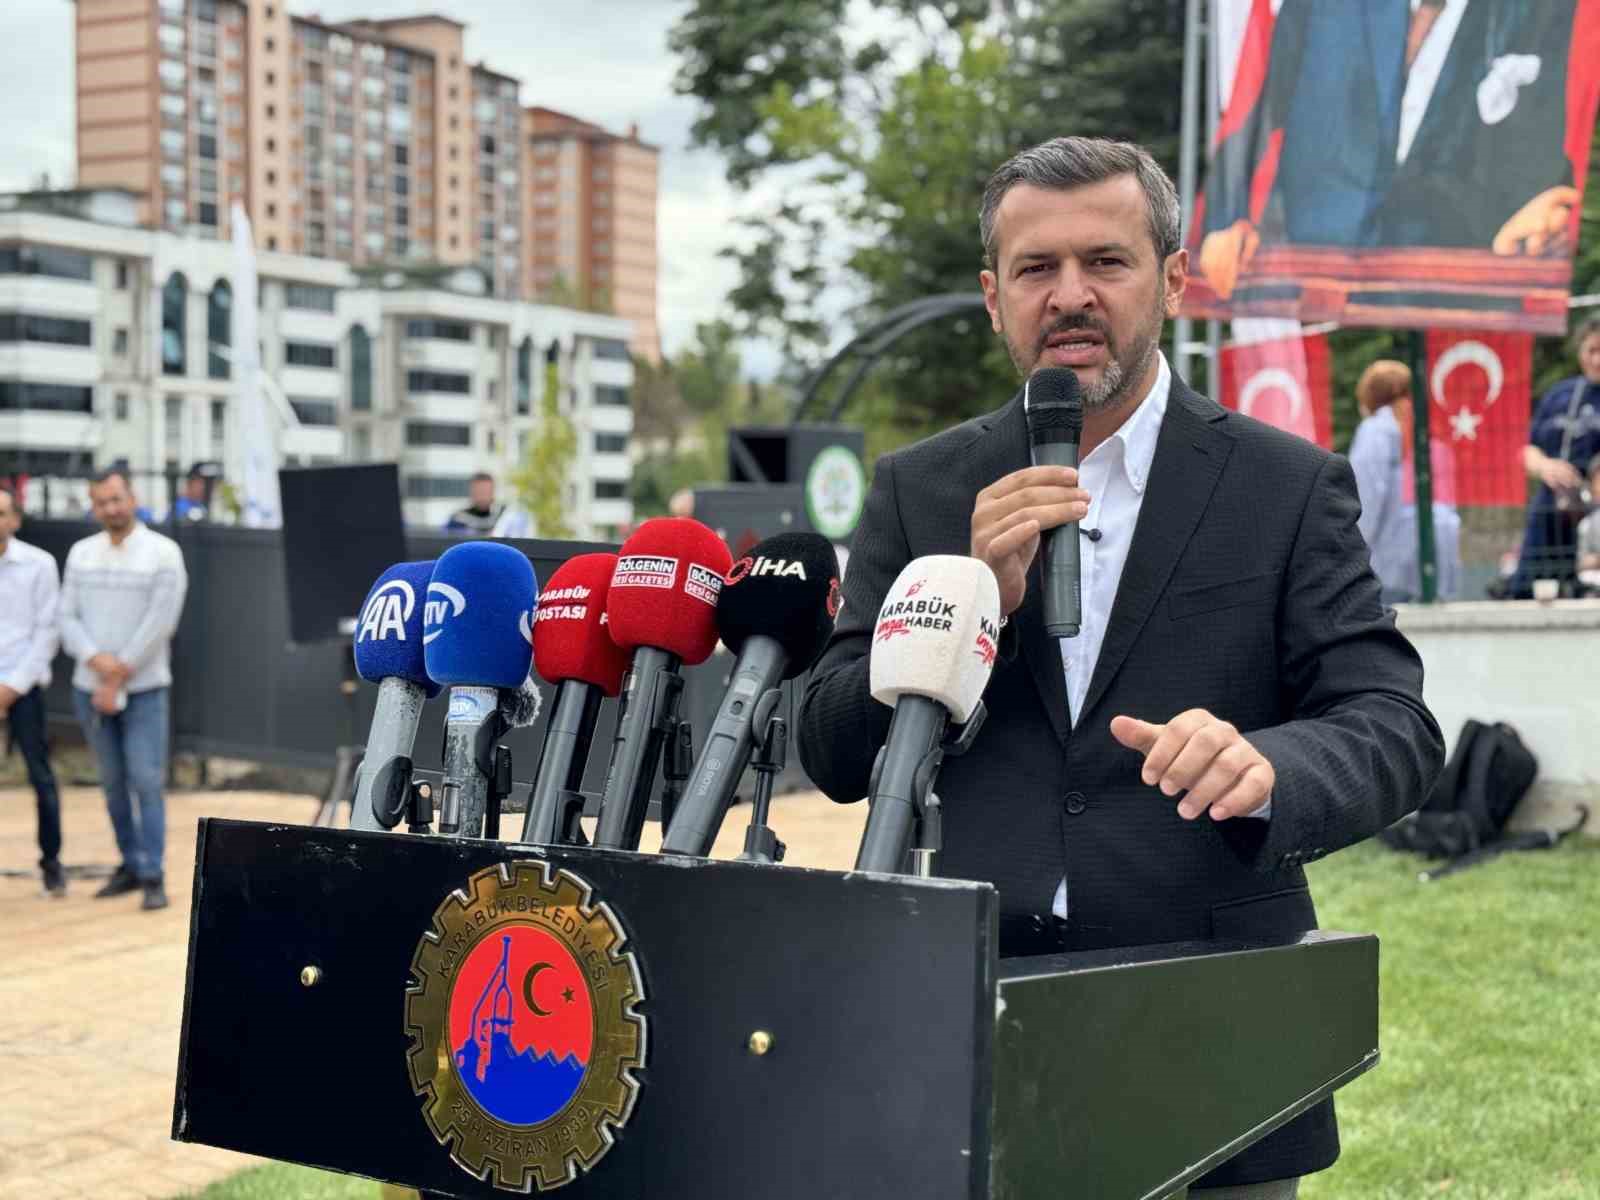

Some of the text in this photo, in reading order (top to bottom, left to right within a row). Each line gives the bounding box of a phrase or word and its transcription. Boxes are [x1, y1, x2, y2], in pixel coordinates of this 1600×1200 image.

[881, 596, 956, 618] KARABÜK
[358, 594, 406, 643] AA
[904, 616, 953, 632] HABER
